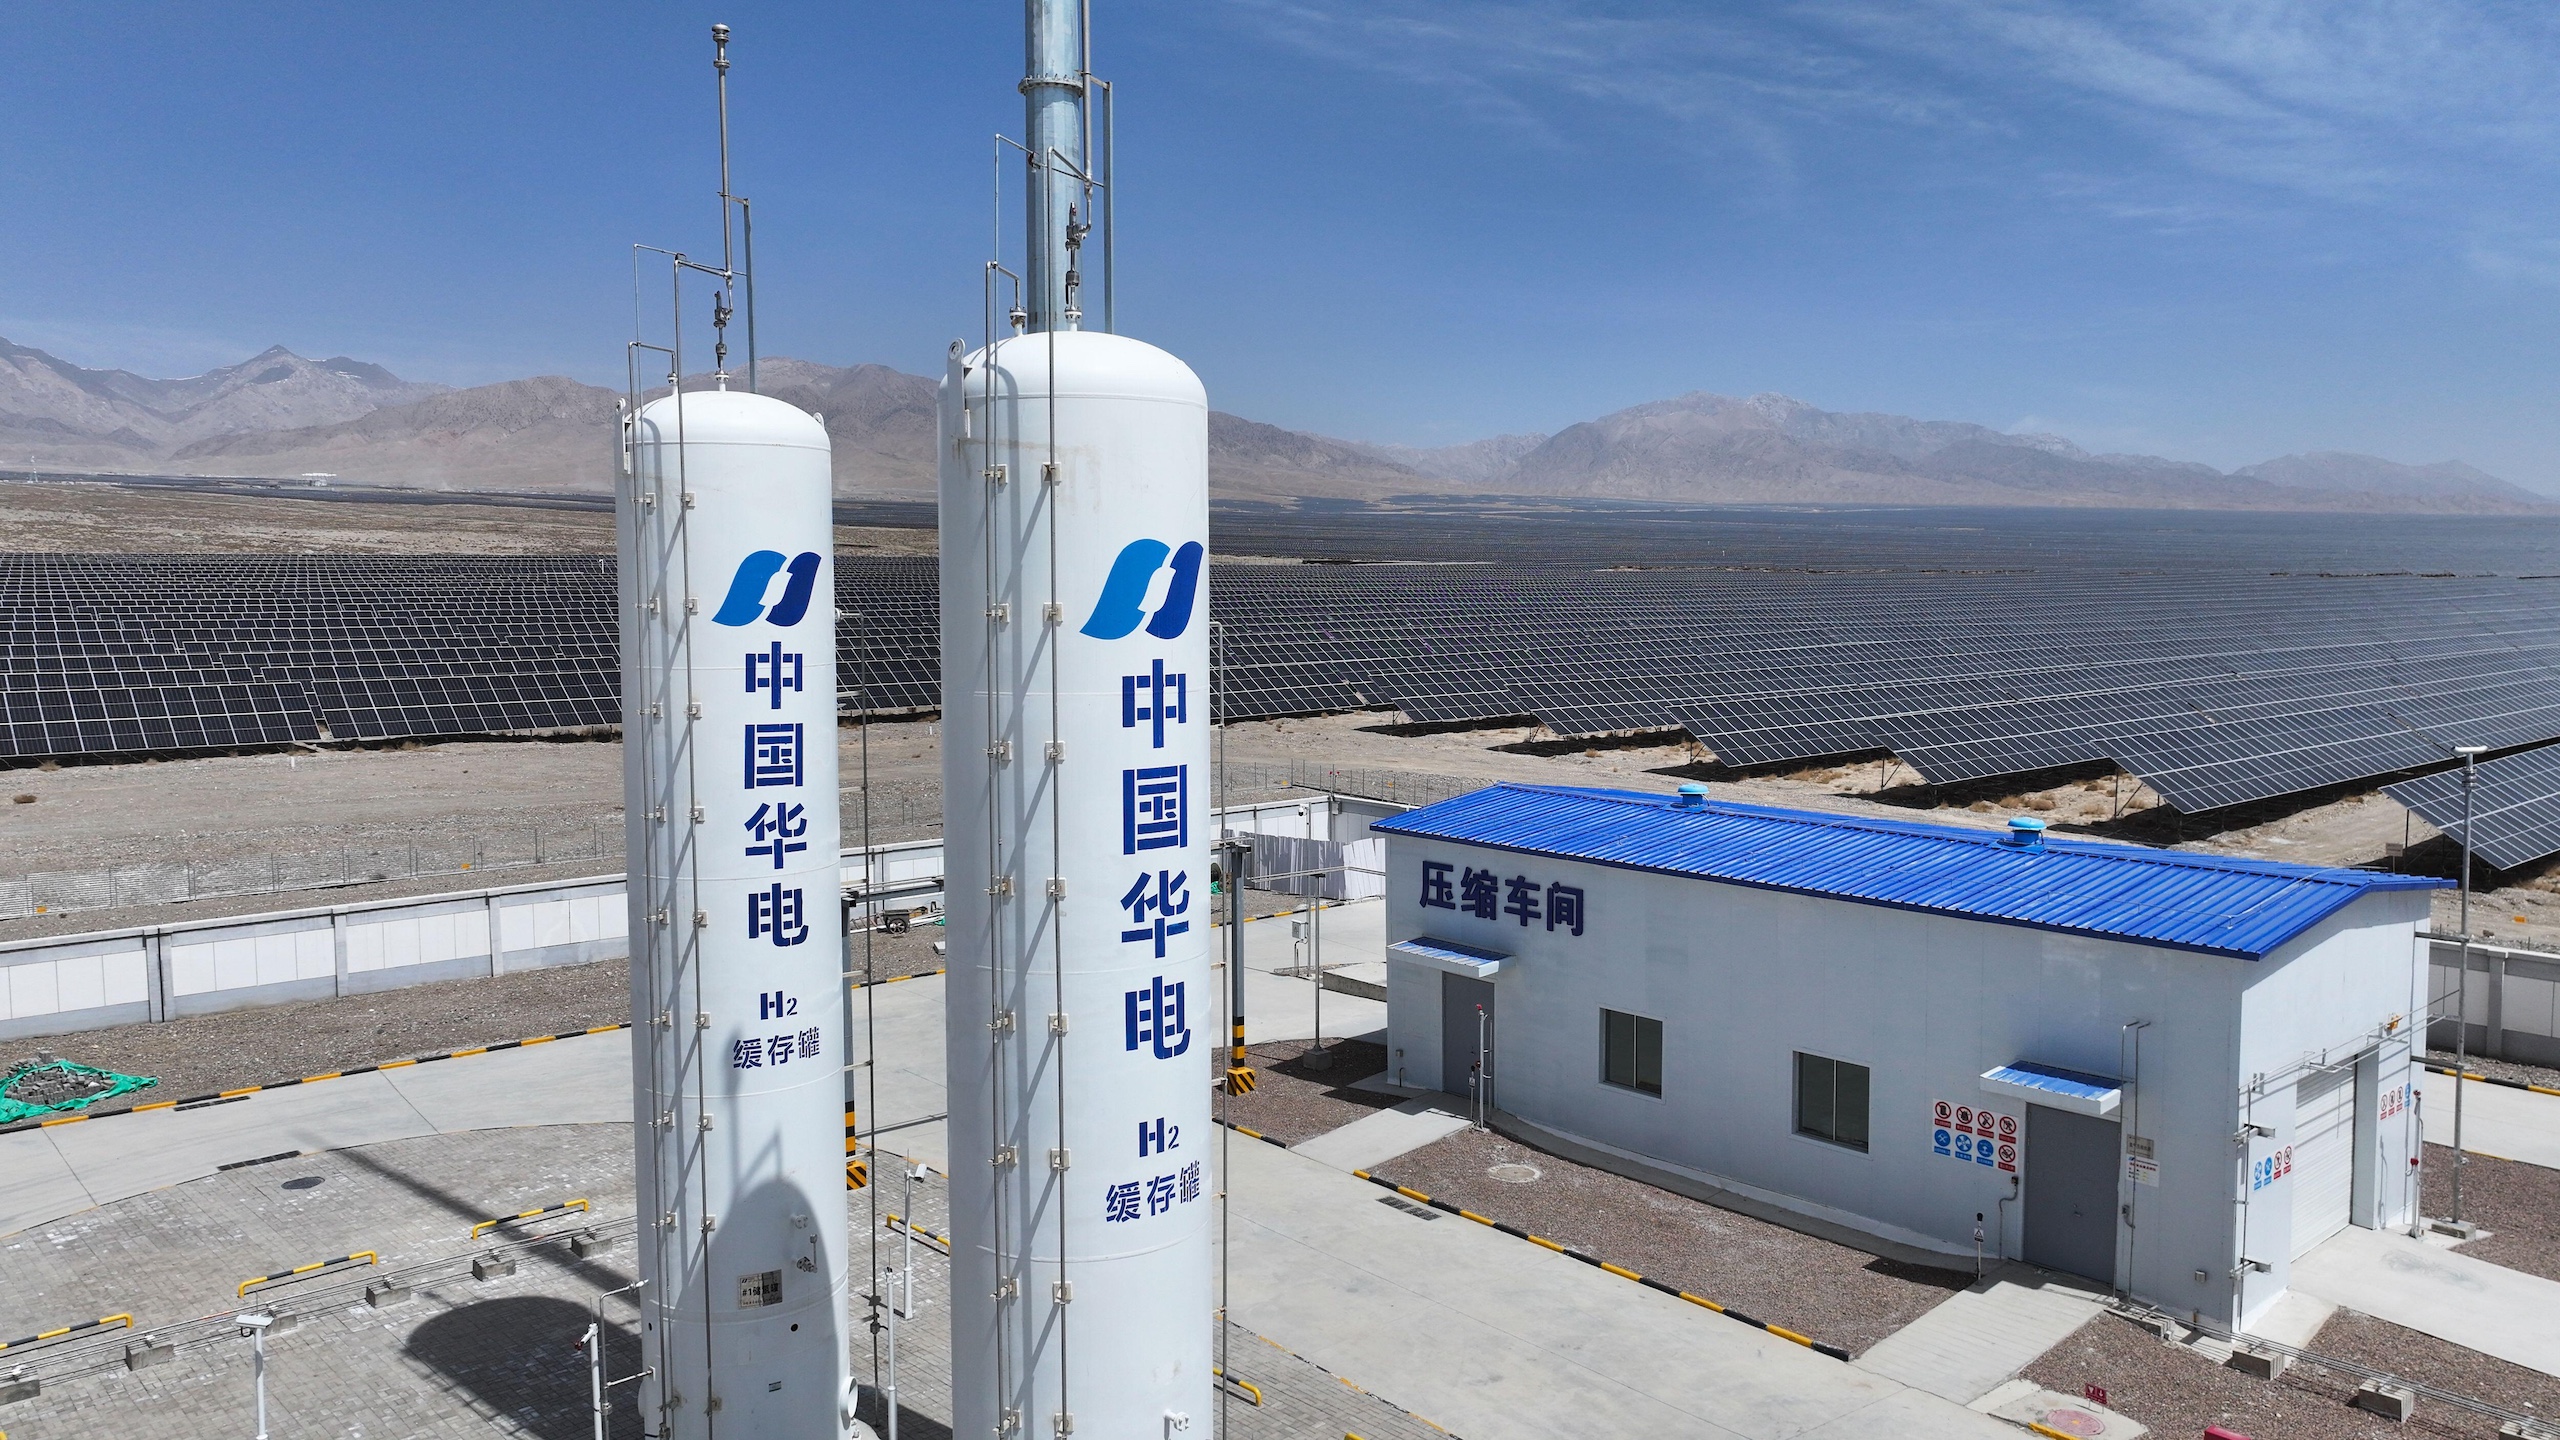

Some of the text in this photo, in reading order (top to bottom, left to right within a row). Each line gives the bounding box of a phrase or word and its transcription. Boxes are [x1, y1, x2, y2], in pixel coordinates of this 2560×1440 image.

[744, 641, 808, 947] 中国华电
[1120, 658, 1191, 1060] 中国华电
[1419, 860, 1584, 936] 压缩车间
[760, 990, 798, 1020] H2
[733, 1026, 820, 1069] 缓存罐
[1138, 1117, 1180, 1158] H2
[1105, 1160, 1200, 1223] 缓存罐
